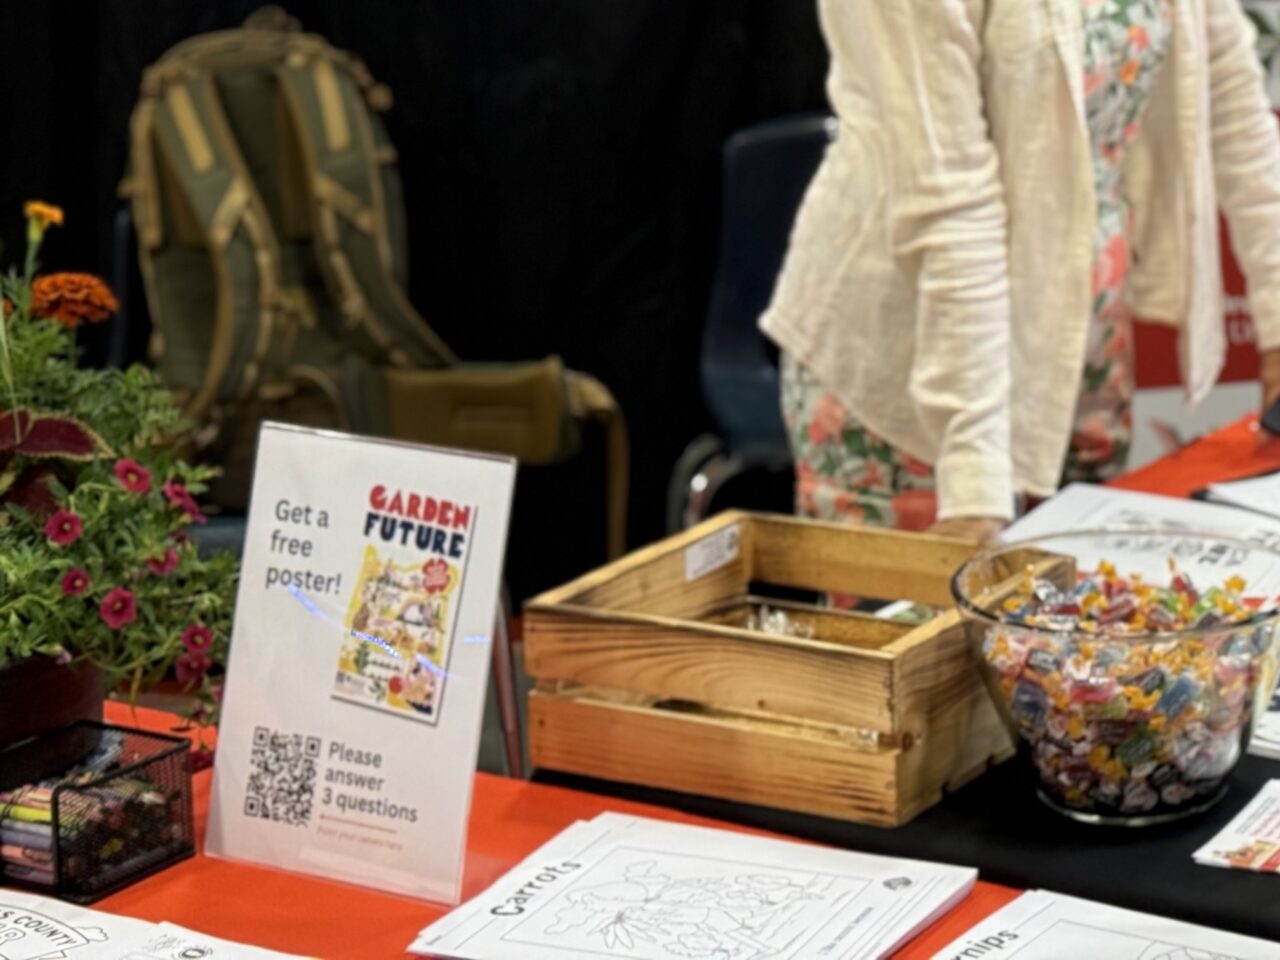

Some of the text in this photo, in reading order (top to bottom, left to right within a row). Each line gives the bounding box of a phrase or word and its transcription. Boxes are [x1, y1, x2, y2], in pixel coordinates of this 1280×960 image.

[274, 499, 330, 528] Get a
[368, 483, 472, 531] GARDEN
[269, 529, 314, 558] free
[363, 511, 466, 559] FUTURE
[264, 565, 343, 595] poster!
[328, 740, 383, 769] Please
[324, 767, 385, 792] answer
[321, 786, 419, 824] 3 questions
[489, 860, 582, 917] Carrots
[13, 915, 78, 947] COUNTY
